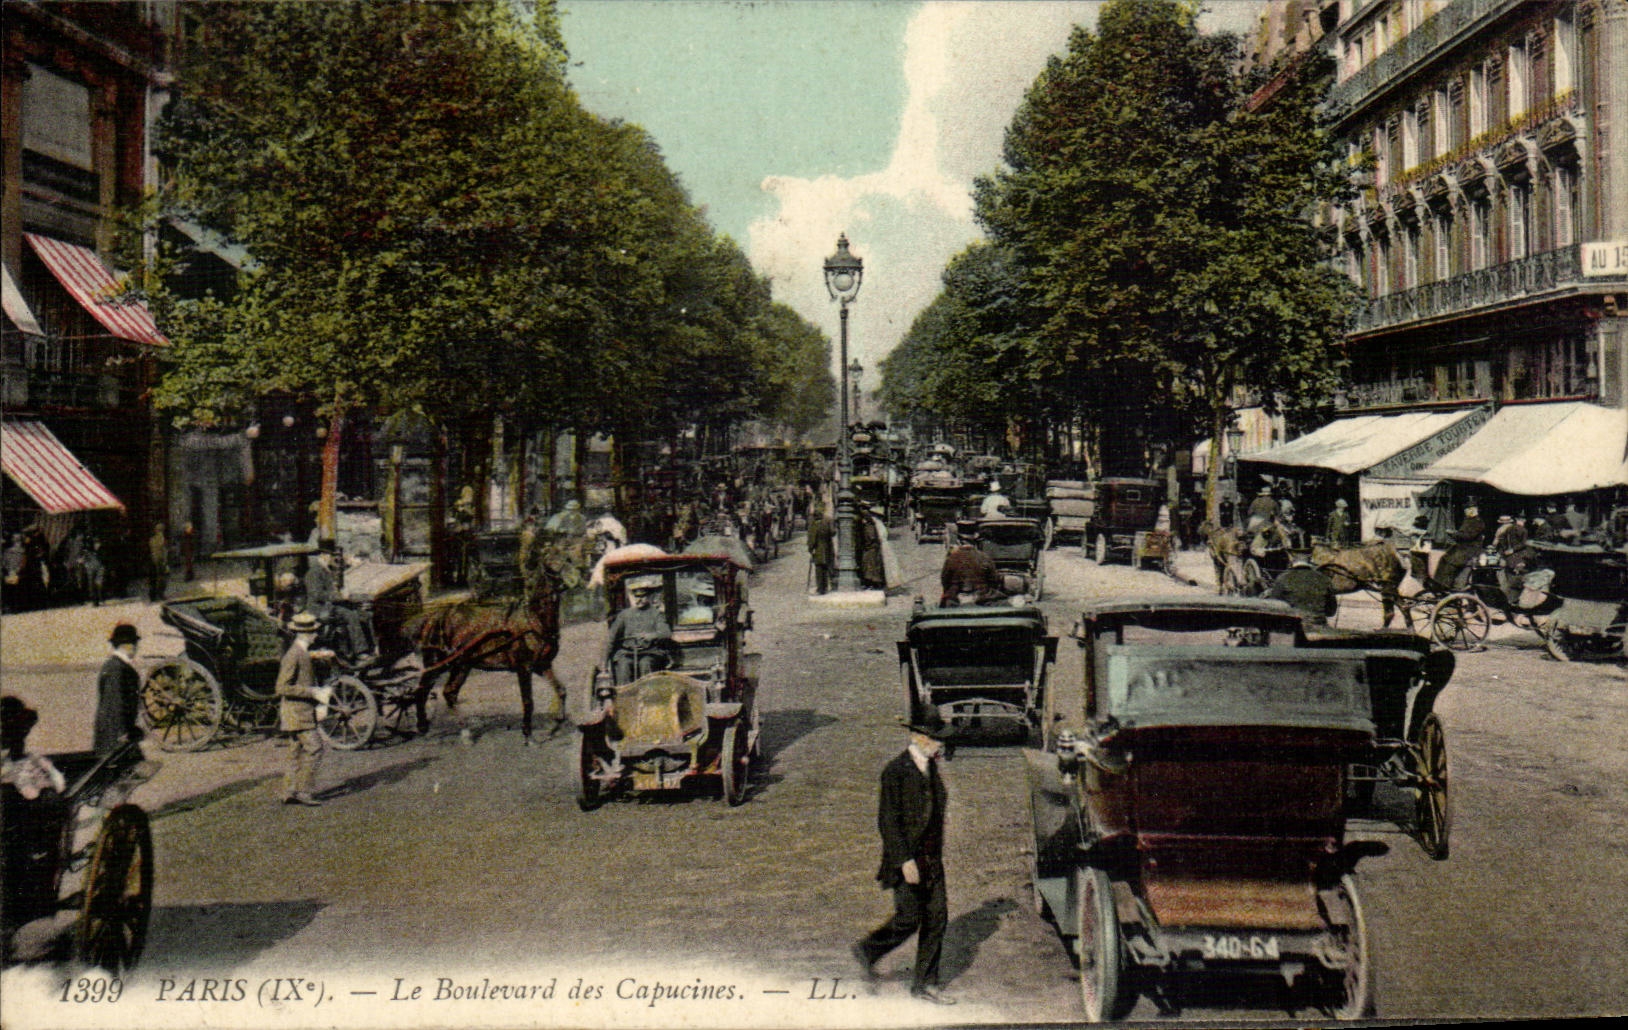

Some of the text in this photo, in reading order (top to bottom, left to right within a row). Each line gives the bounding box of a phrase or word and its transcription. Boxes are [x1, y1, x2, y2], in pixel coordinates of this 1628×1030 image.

[1591, 249, 1606, 269] AU
[1383, 441, 1433, 472] TAVERNE
[1362, 497, 1411, 509] TAVERNE
